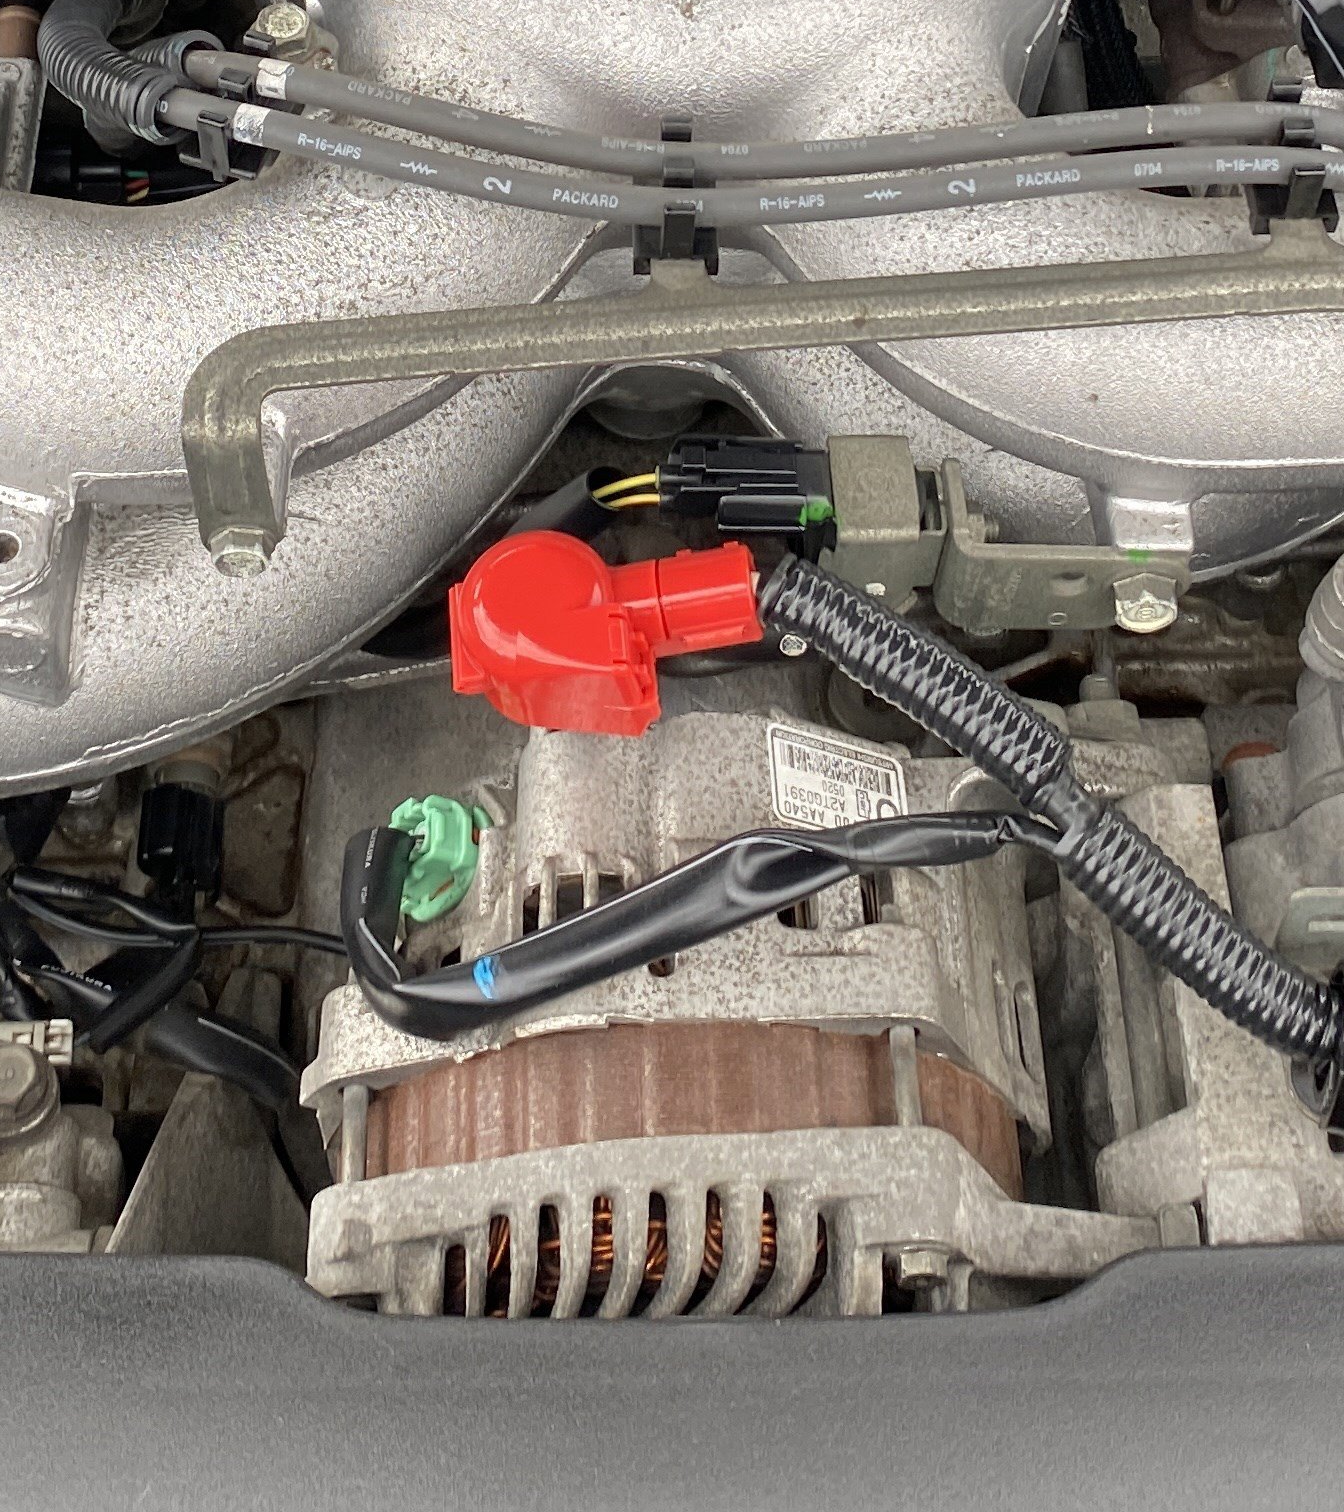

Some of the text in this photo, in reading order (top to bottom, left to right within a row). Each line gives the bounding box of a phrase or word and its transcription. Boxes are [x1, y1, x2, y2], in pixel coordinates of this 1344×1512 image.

[552, 189, 619, 209] PACKARD
[1015, 169, 1081, 187] PACKARD
[1134, 162, 1162, 176] 0704
[784, 800, 825, 823] AA540
